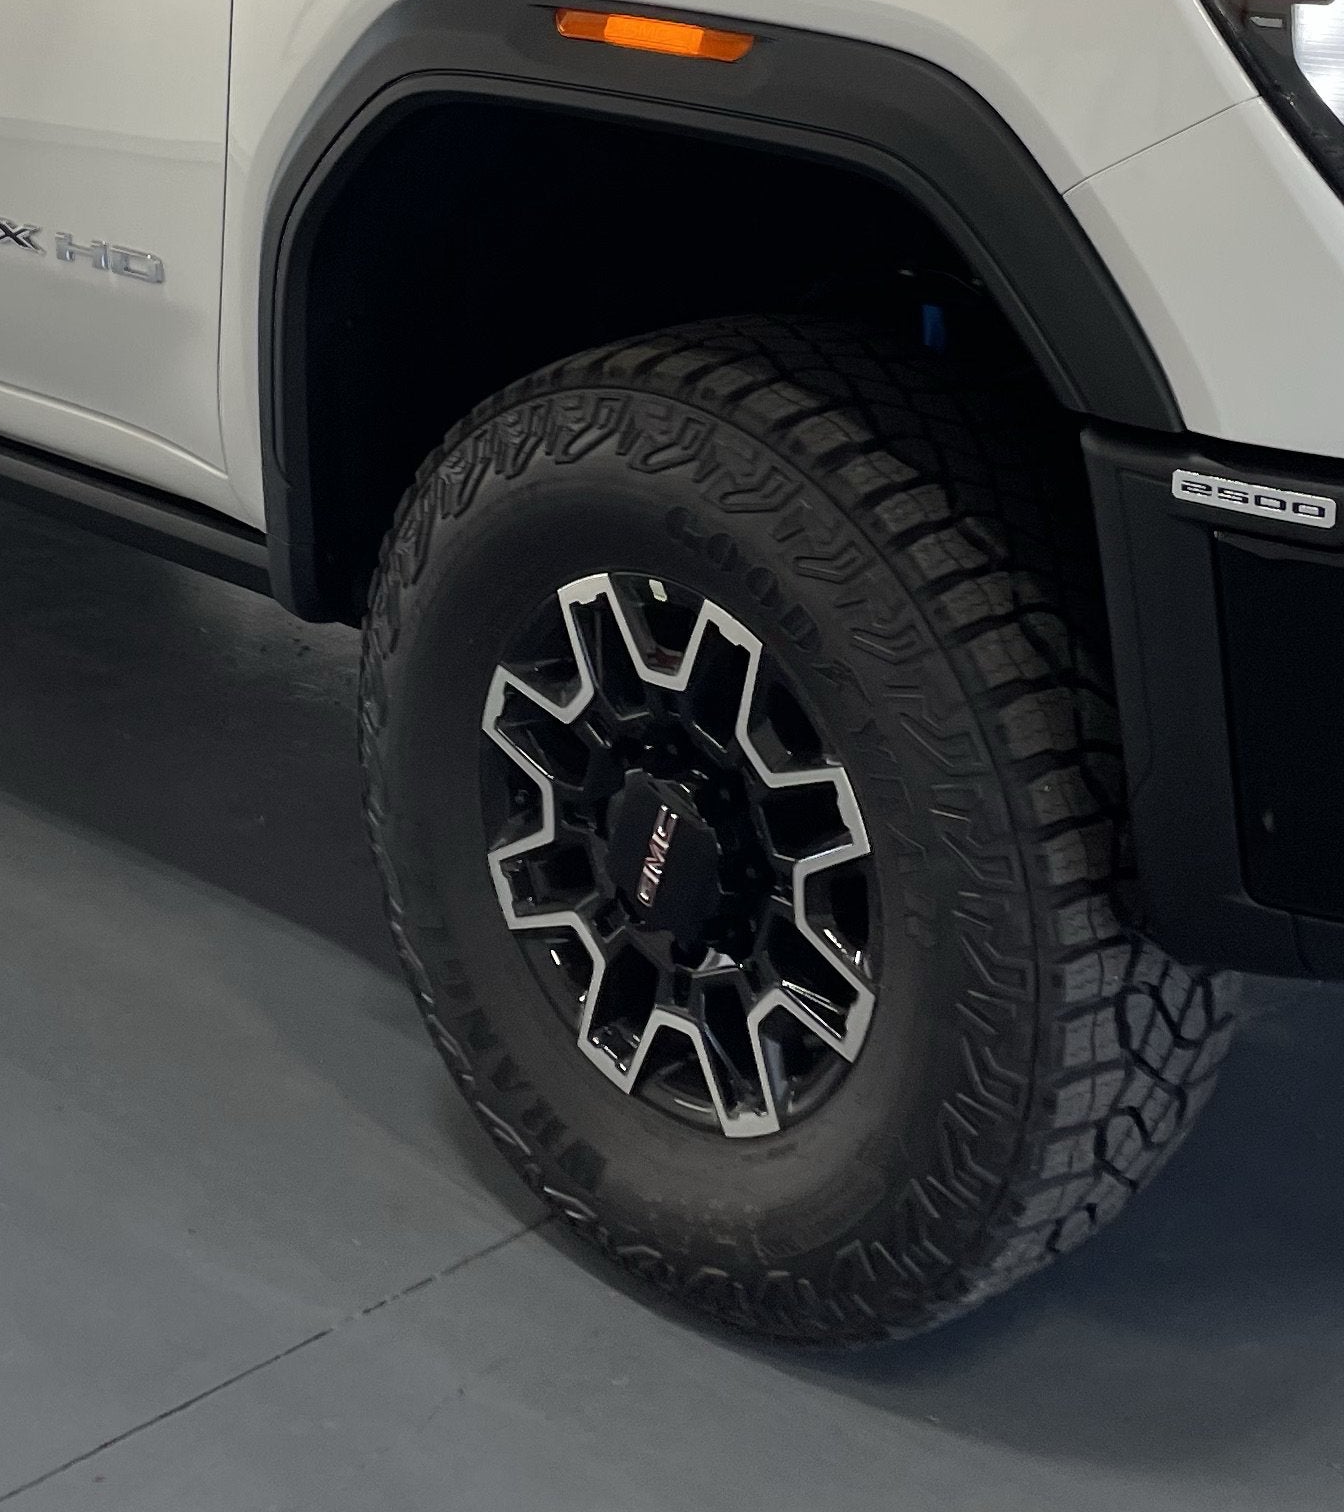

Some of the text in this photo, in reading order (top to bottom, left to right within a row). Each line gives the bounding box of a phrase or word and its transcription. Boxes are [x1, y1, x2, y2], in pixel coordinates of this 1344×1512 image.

[55, 231, 165, 284] HD
[1181, 480, 1325, 519] 2500
[637, 804, 678, 908] GMC
